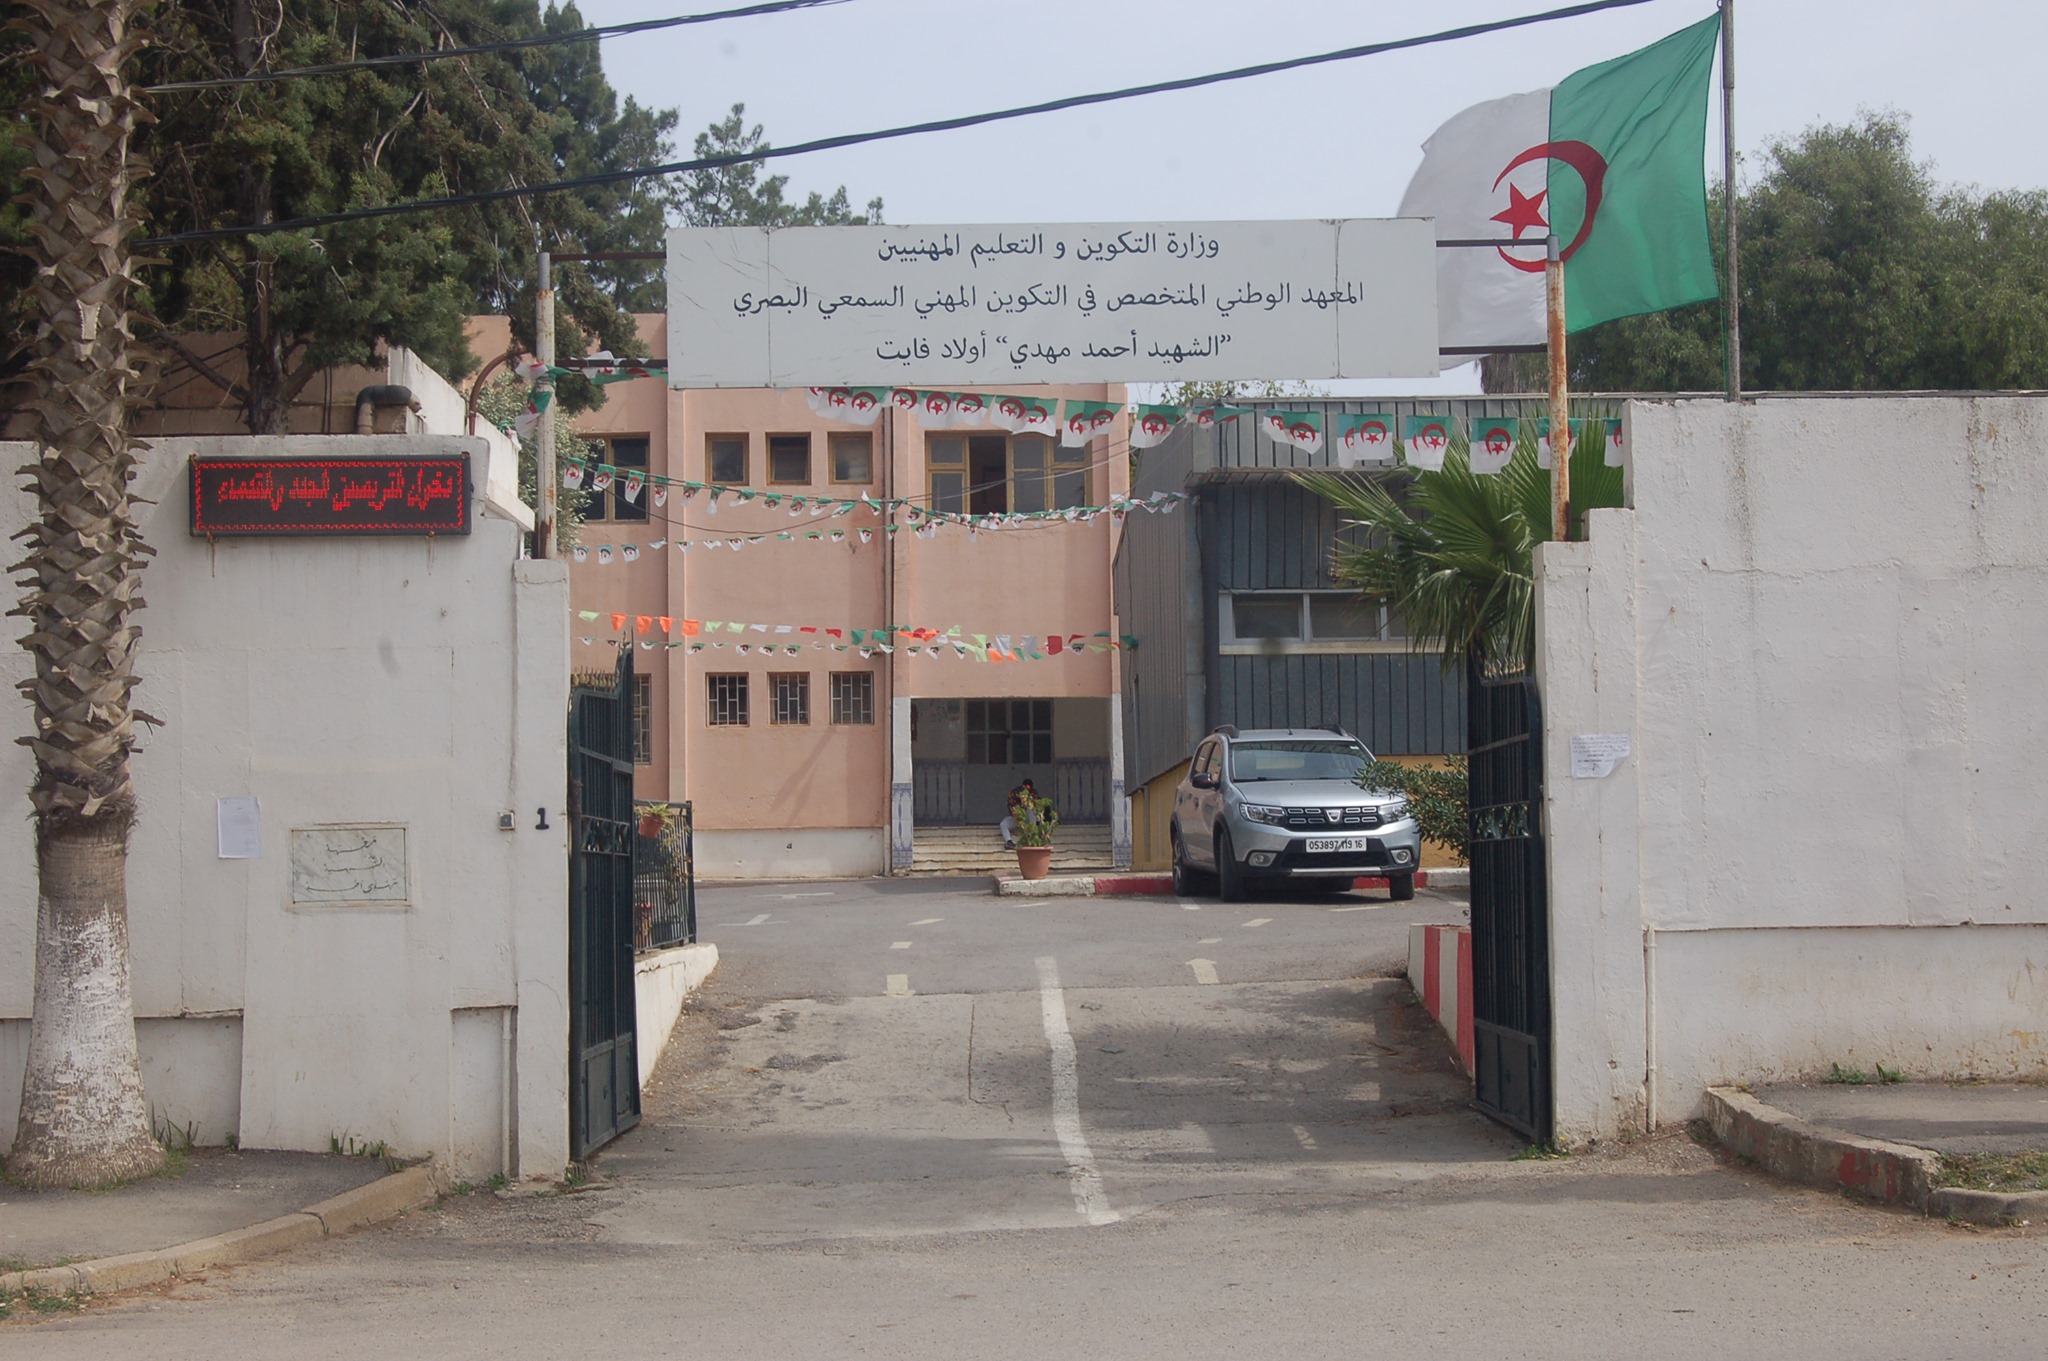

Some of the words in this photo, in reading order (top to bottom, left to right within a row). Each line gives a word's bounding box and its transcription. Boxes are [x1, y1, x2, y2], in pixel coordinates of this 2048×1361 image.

[877, 233, 961, 263] المهنيين
[969, 233, 1044, 269] التعليم
[1053, 241, 1067, 260] و
[1076, 230, 1157, 262] التكوين
[1166, 231, 1220, 259] وزارة
[733, 285, 808, 318] البصري
[817, 284, 904, 321] السمعي
[914, 285, 977, 320] المهني
[985, 282, 1068, 314] التكوين
[1077, 283, 1098, 318] في
[1106, 282, 1206, 313] المتخصص
[1216, 281, 1291, 318] الوطني
[1300, 280, 1364, 311] المعهد
[875, 337, 931, 367] فايت
[940, 329, 987, 364] أولاد
[1081, 329, 1138, 358] أحمد
[535, 807, 550, 831] 1
